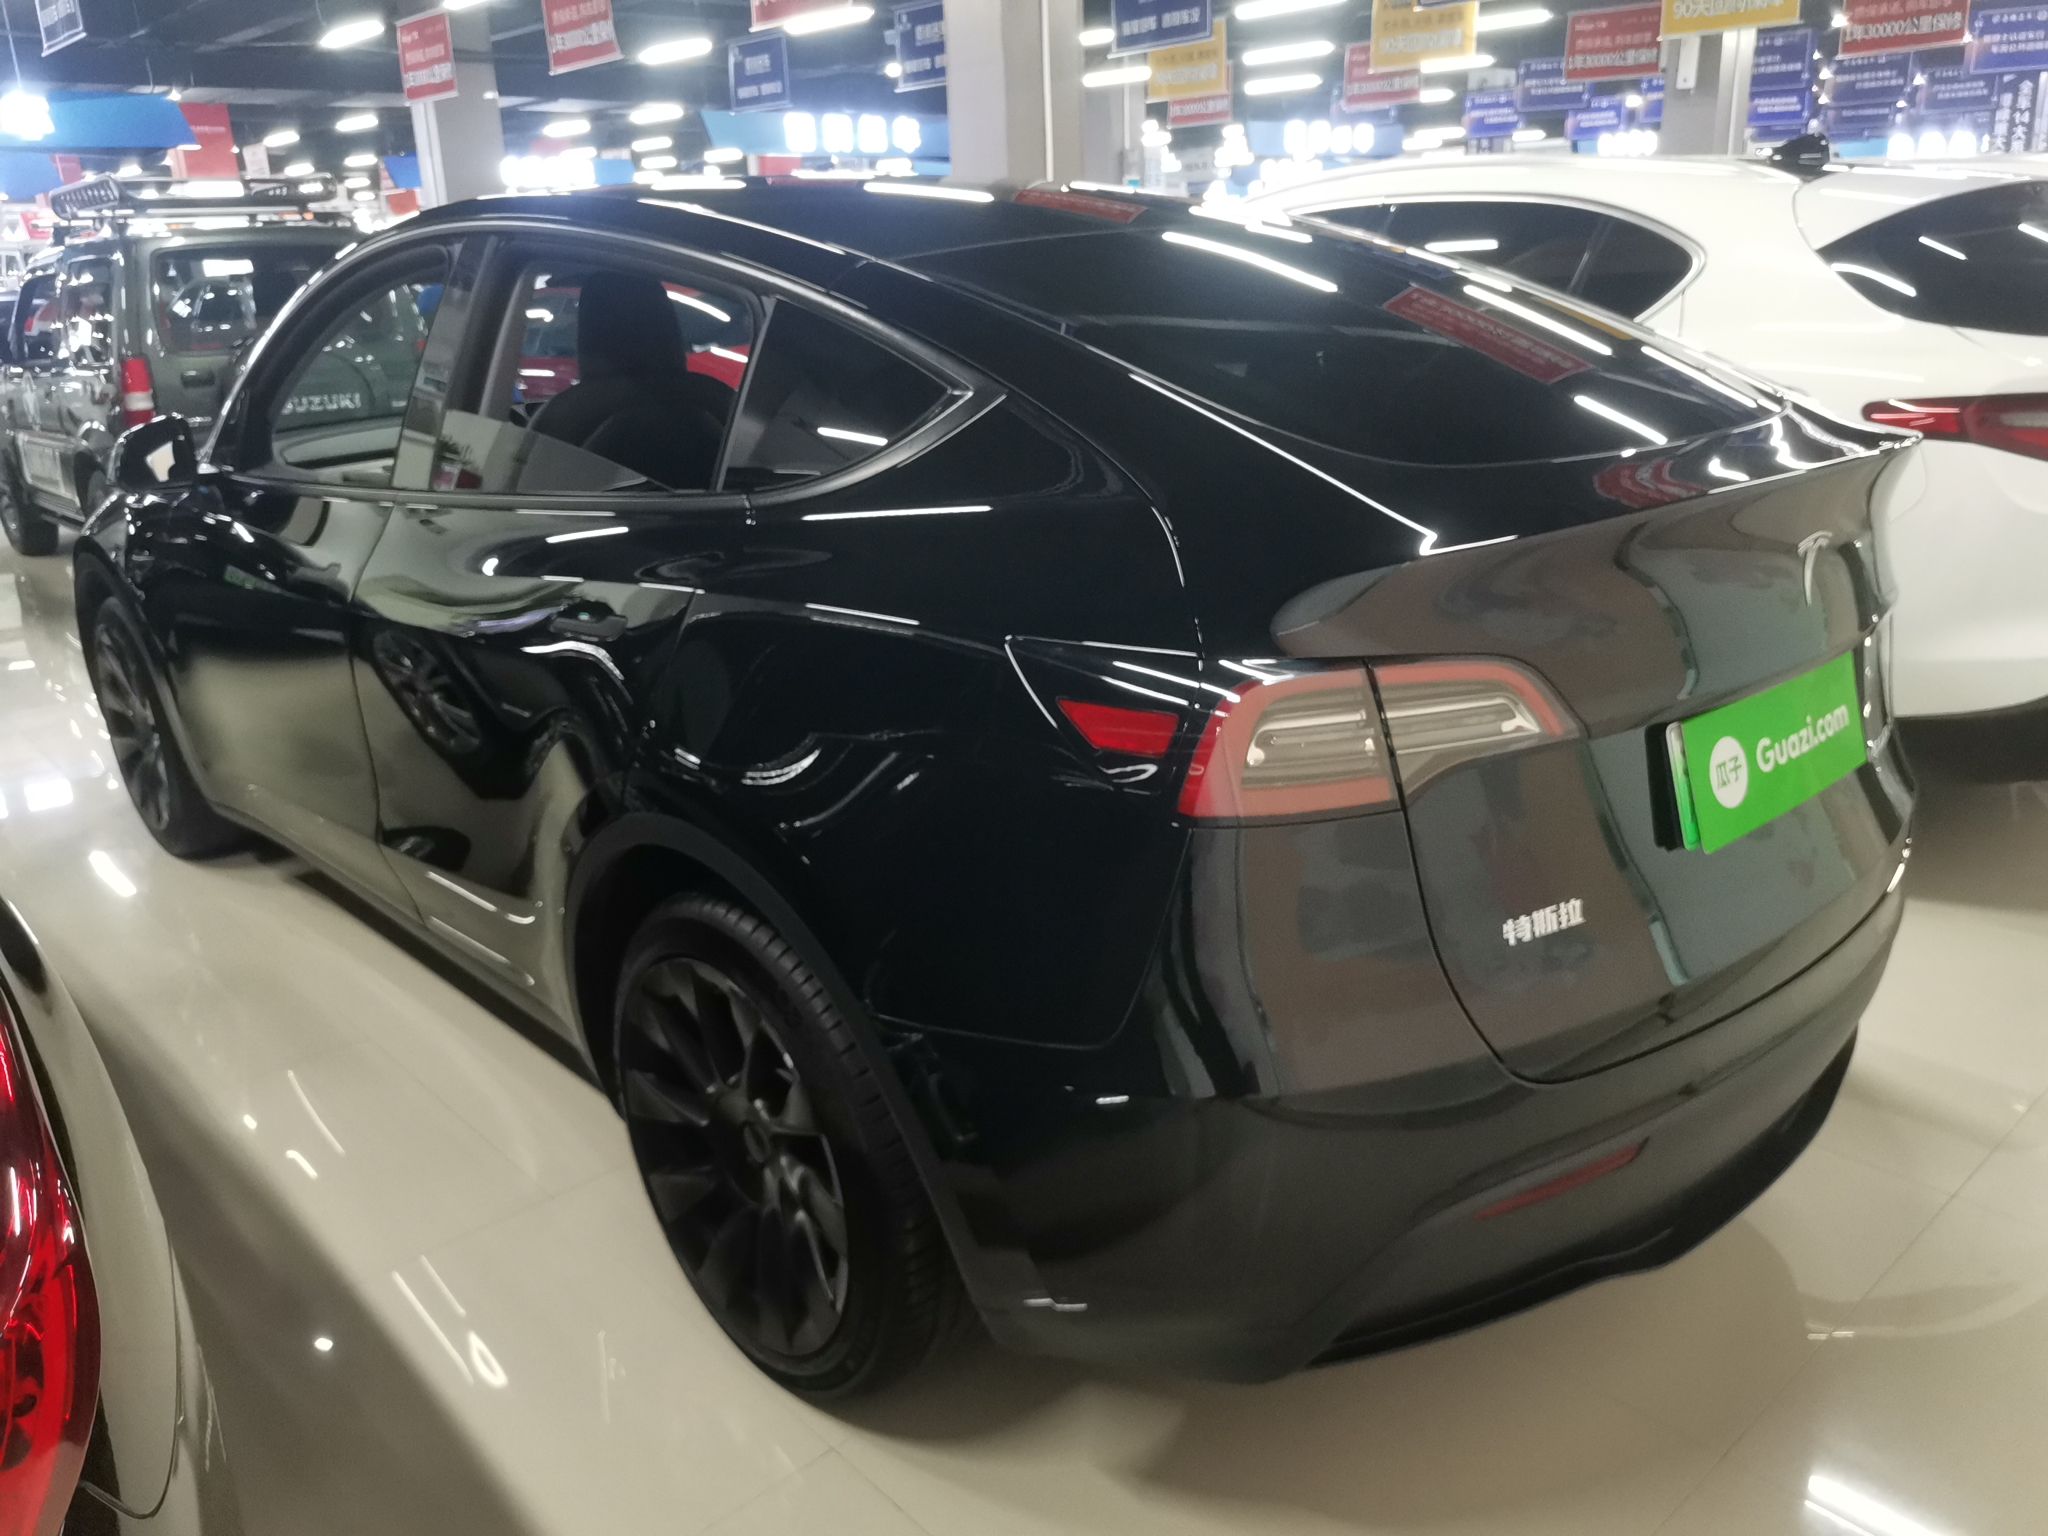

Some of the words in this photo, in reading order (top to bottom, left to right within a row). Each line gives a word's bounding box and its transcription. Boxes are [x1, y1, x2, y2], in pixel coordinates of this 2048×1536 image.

[1716, 756, 1742, 789] 瓜子
[1756, 704, 1849, 773] Guazi.com
[1502, 898, 1586, 946] 特斯拉
